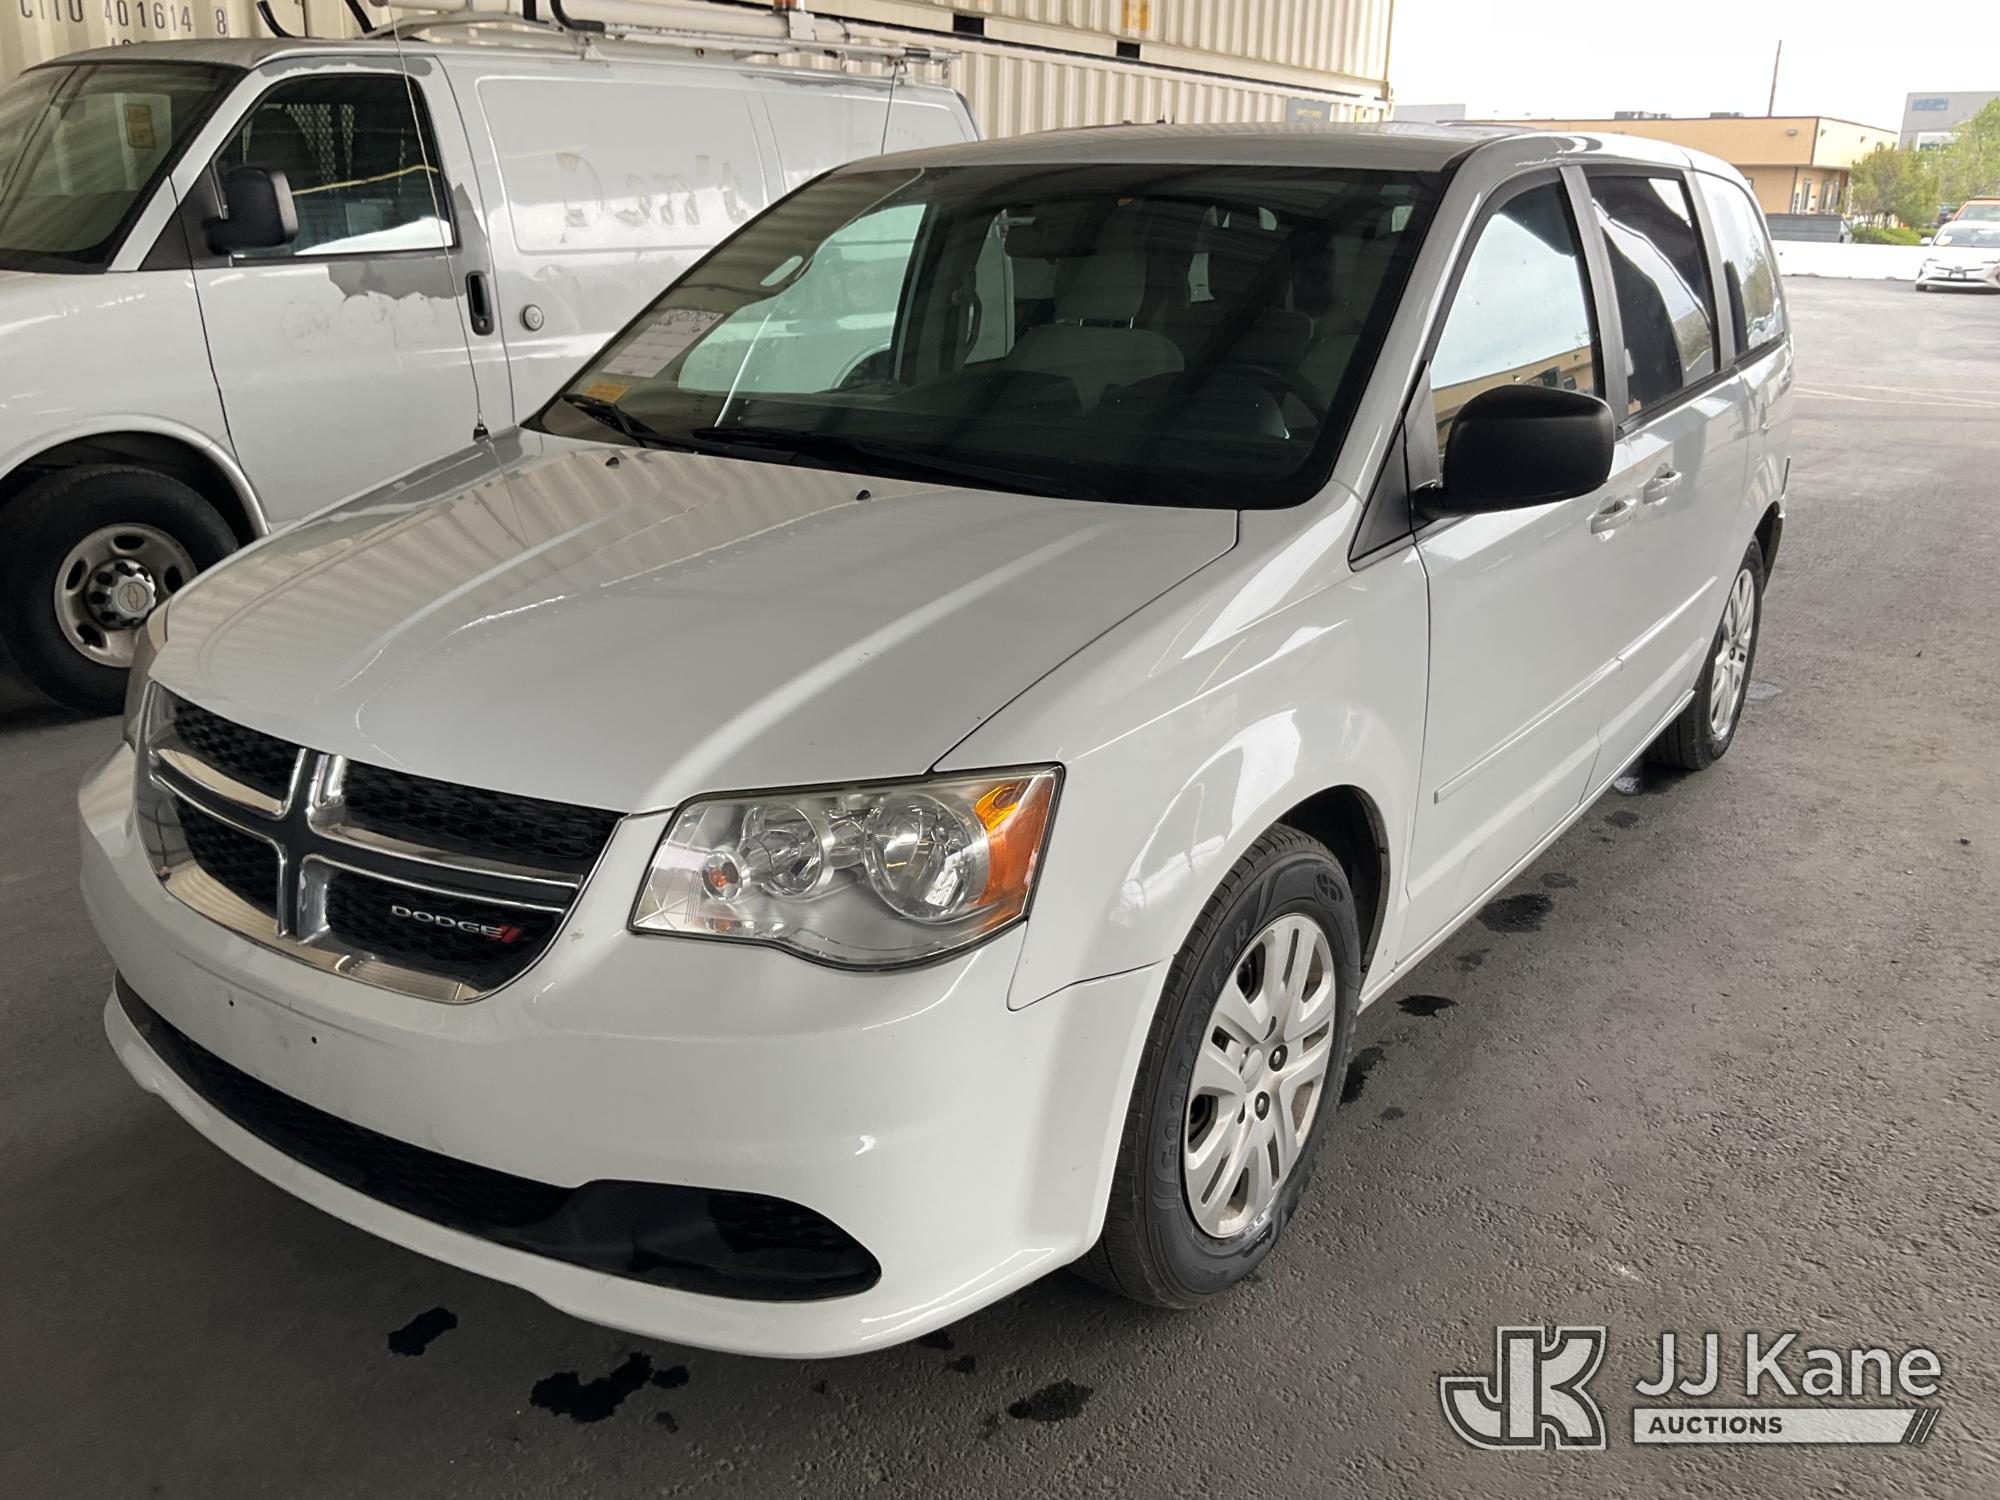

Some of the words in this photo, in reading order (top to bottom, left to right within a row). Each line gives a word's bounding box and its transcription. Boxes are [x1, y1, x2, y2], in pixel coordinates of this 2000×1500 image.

[105, 0, 192, 32] 401614
[215, 9, 227, 35] 8
[391, 904, 503, 938] DODGE
